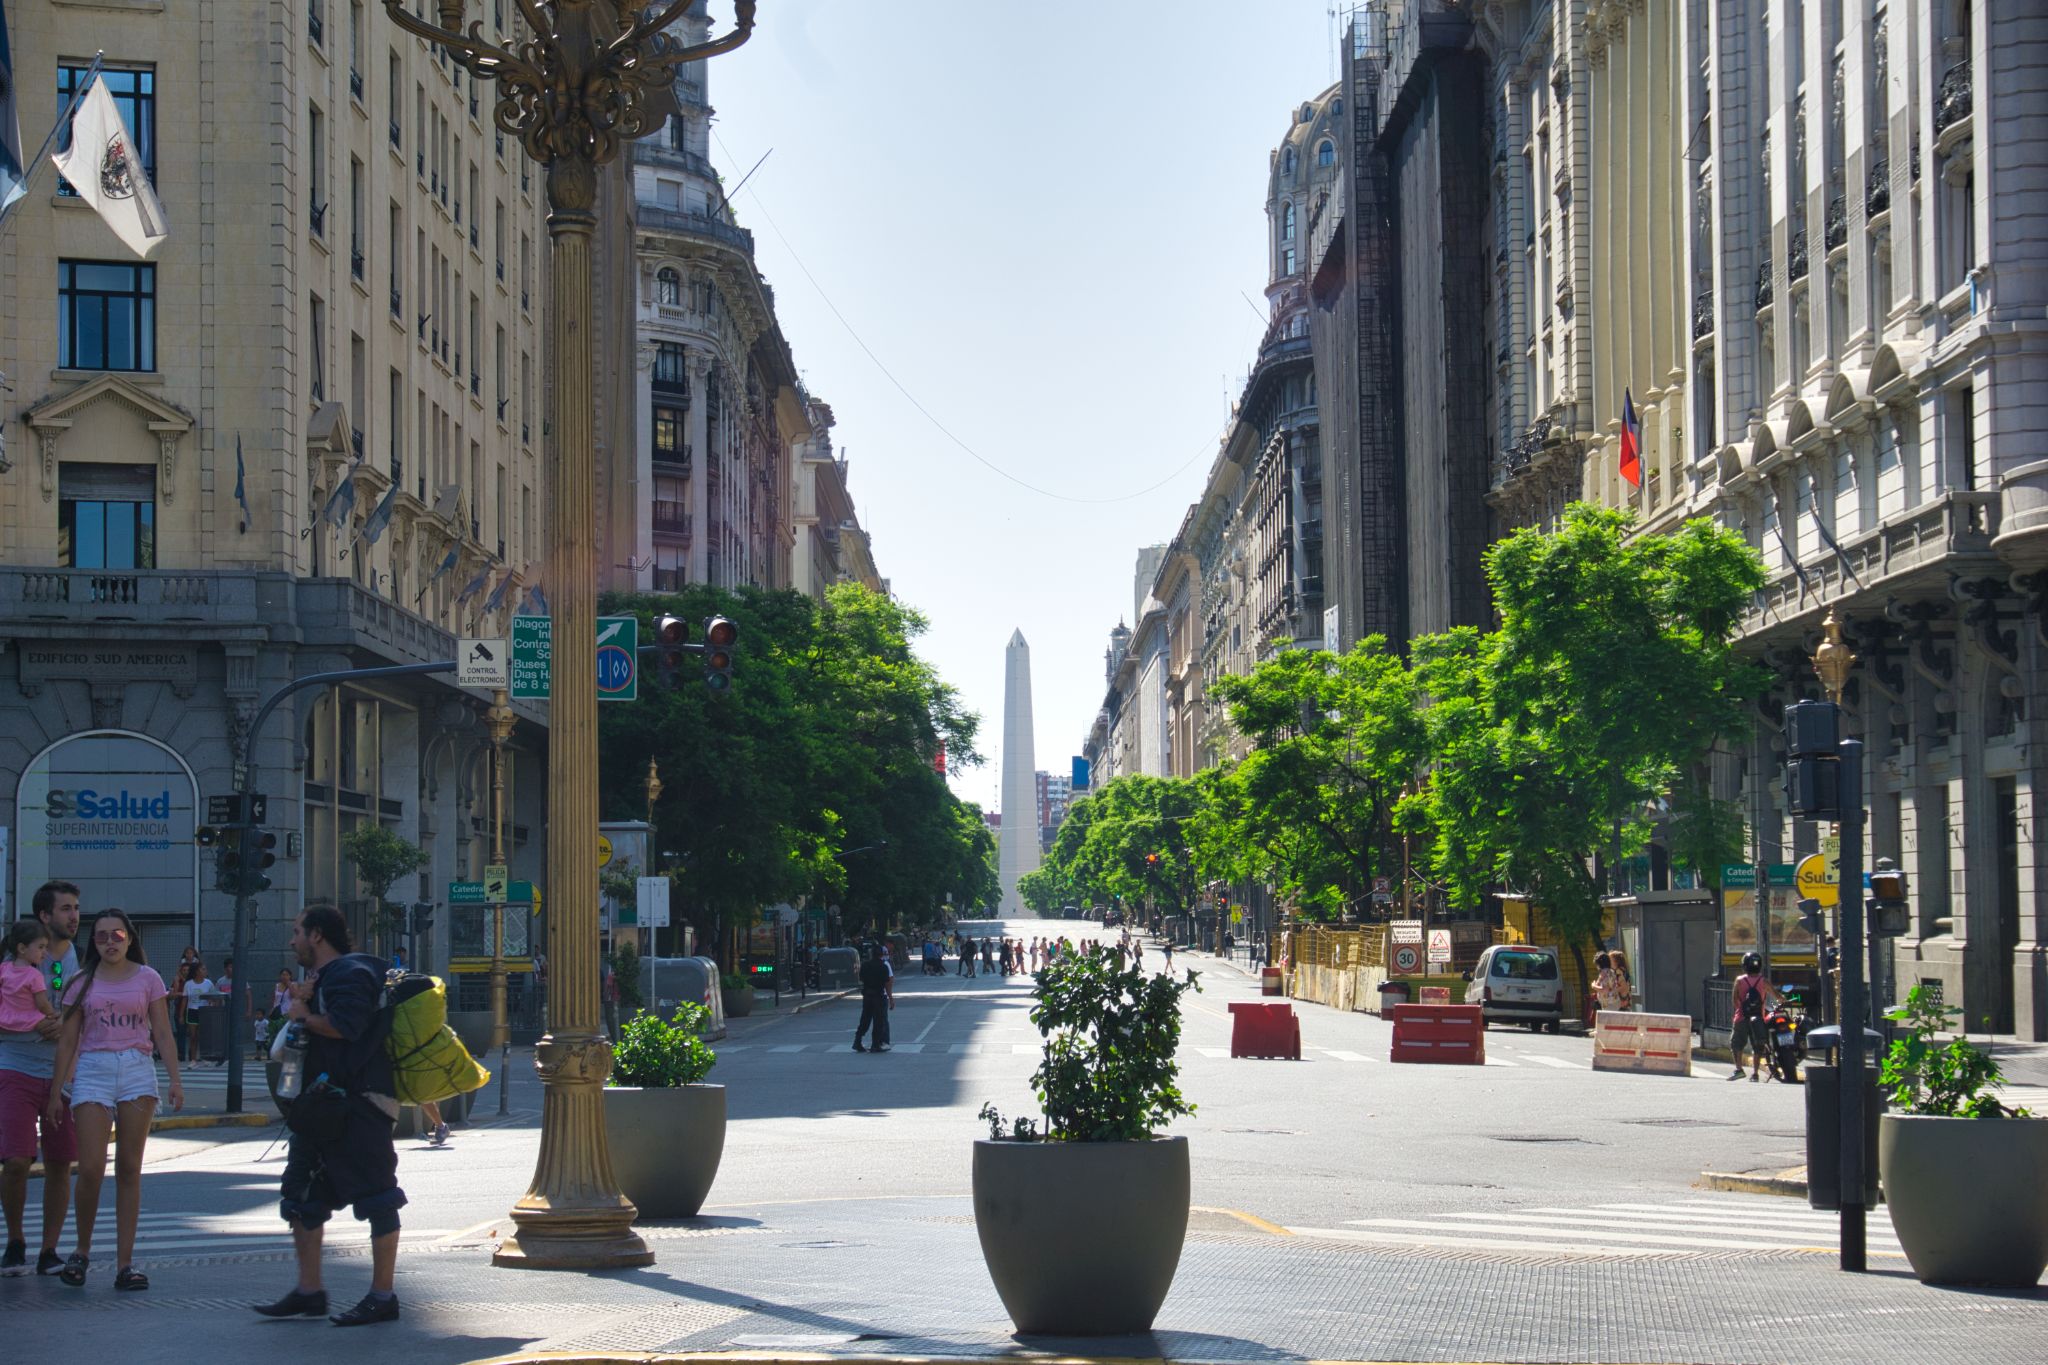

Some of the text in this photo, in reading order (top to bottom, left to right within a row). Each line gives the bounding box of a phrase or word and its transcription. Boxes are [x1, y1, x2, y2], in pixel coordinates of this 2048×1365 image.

[28, 653, 187, 665] EDIFICIO SUD AMERICA
[514, 658, 547, 669] Buses
[459, 676, 505, 684] ELECTRONICO
[513, 680, 528, 689] de
[530, 679, 539, 689] 8
[45, 823, 169, 836] SUPERINTENDENCIA
[63, 840, 117, 850] SERVICIOS
[136, 840, 170, 850] SALUD
[1399, 953, 1414, 964] 30
